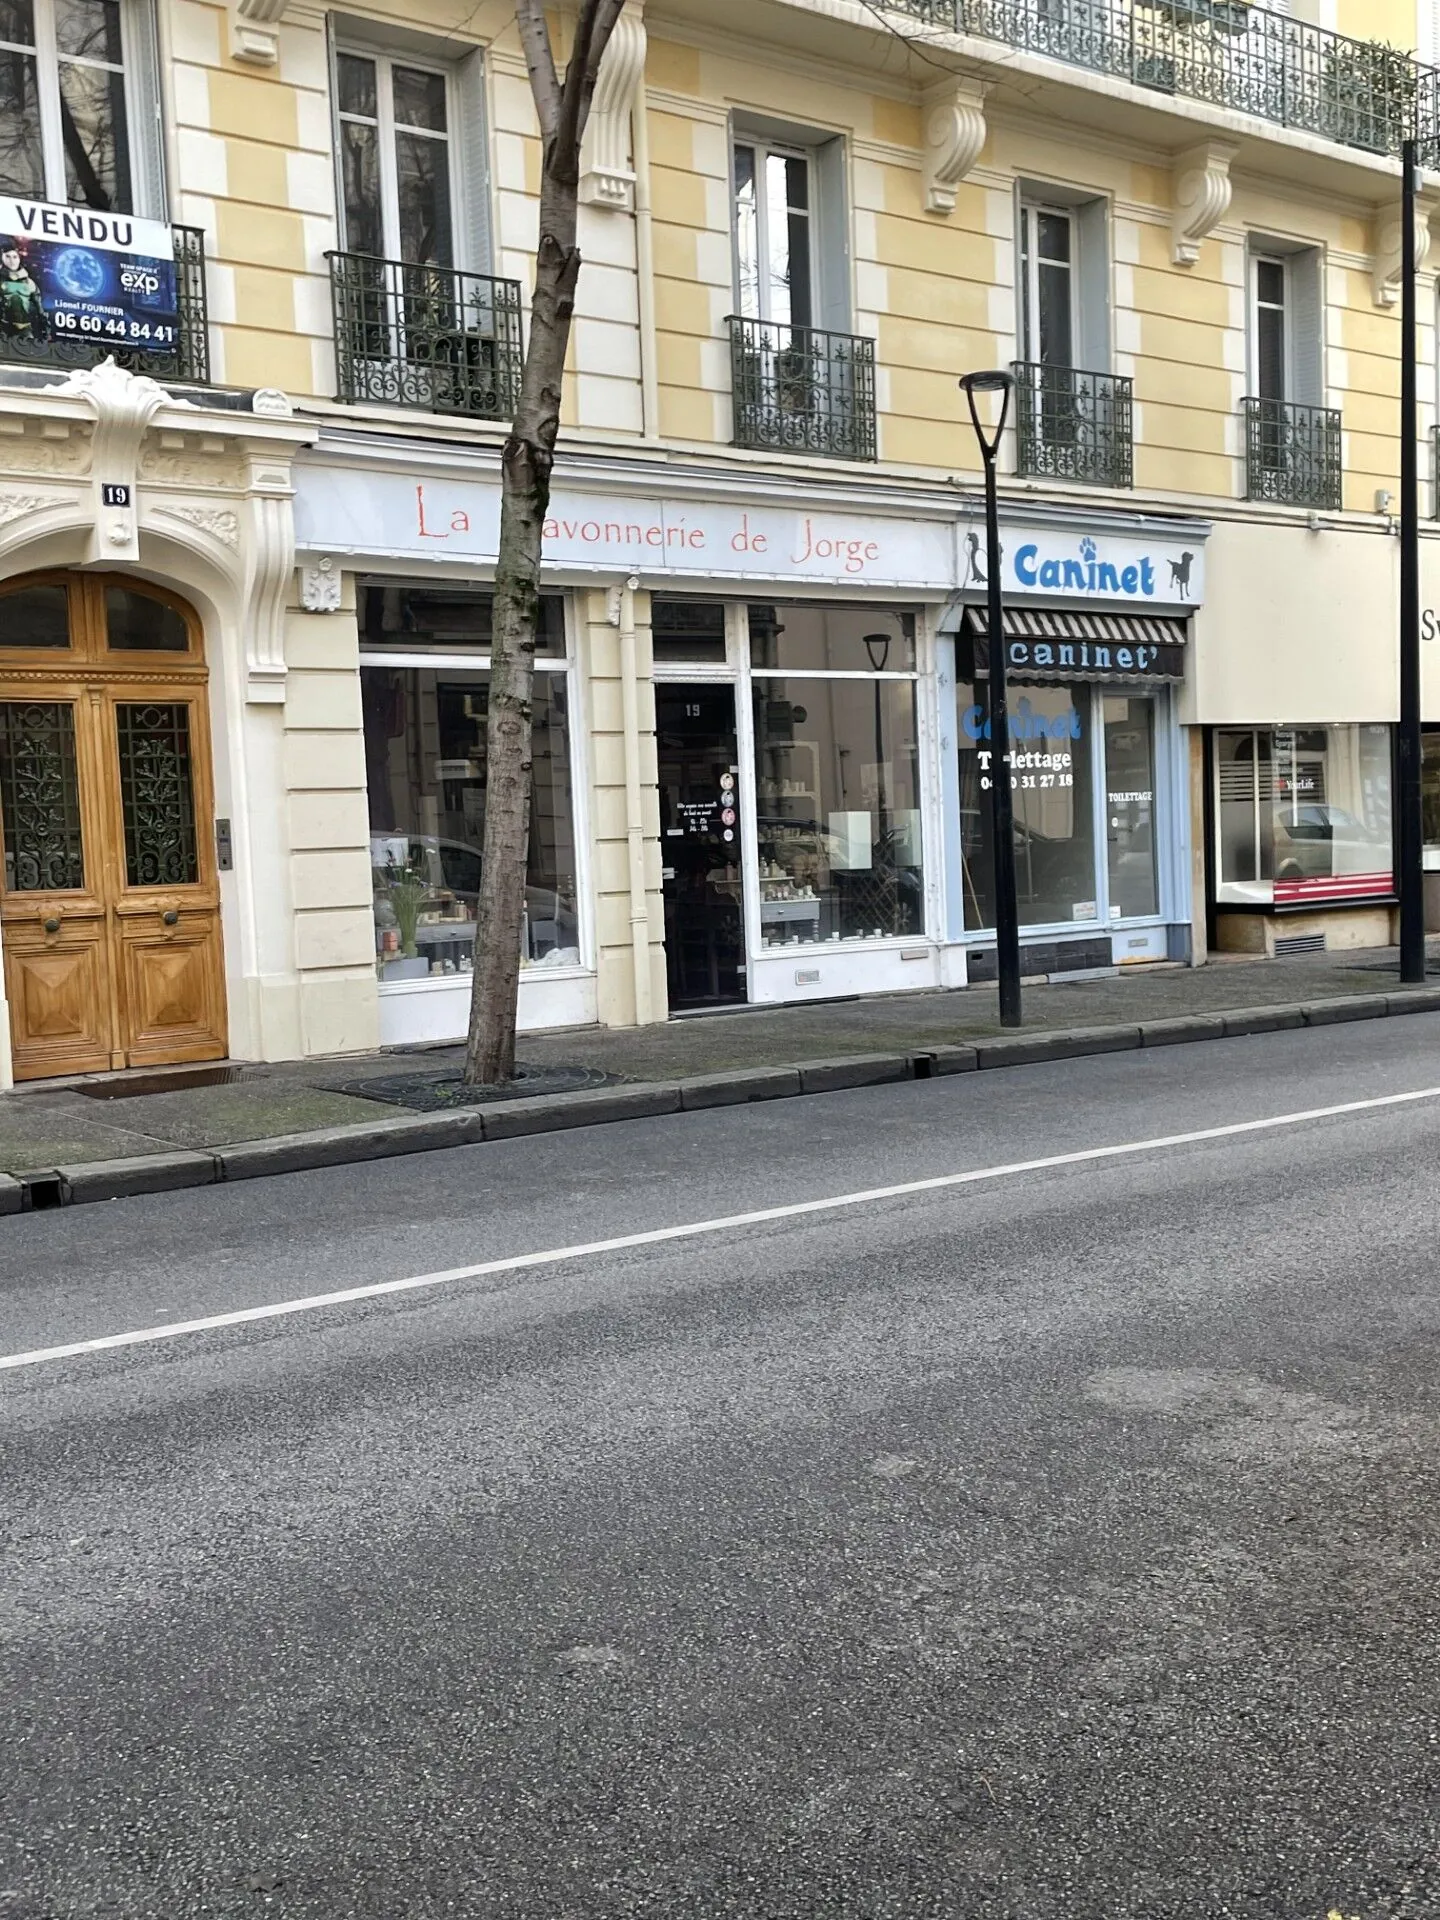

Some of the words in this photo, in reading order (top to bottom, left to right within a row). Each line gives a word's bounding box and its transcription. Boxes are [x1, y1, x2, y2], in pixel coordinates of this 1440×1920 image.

[15, 205, 133, 246] VENDU
[54, 299, 80, 310] Lionel
[81, 303, 124, 317] FOURNIER
[54, 311, 77, 329] 06
[80, 315, 102, 333] 60
[105, 319, 126, 336] 44
[130, 322, 151, 339] 84
[154, 325, 173, 342] 41
[107, 487, 126, 504] 19
[416, 484, 470, 538] La
[541, 517, 705, 548] avonnerie
[731, 513, 768, 553] de
[790, 519, 879, 573] Jorge
[1014, 543, 1155, 596] Caninet
[686, 704, 700, 717] 19
[978, 750, 1071, 771] Tlettage
[1021, 775, 1036, 788] 31
[1040, 774, 1055, 788] 27
[1059, 773, 1073, 787] 18
[1108, 792, 1152, 802] TOILETTAGE
